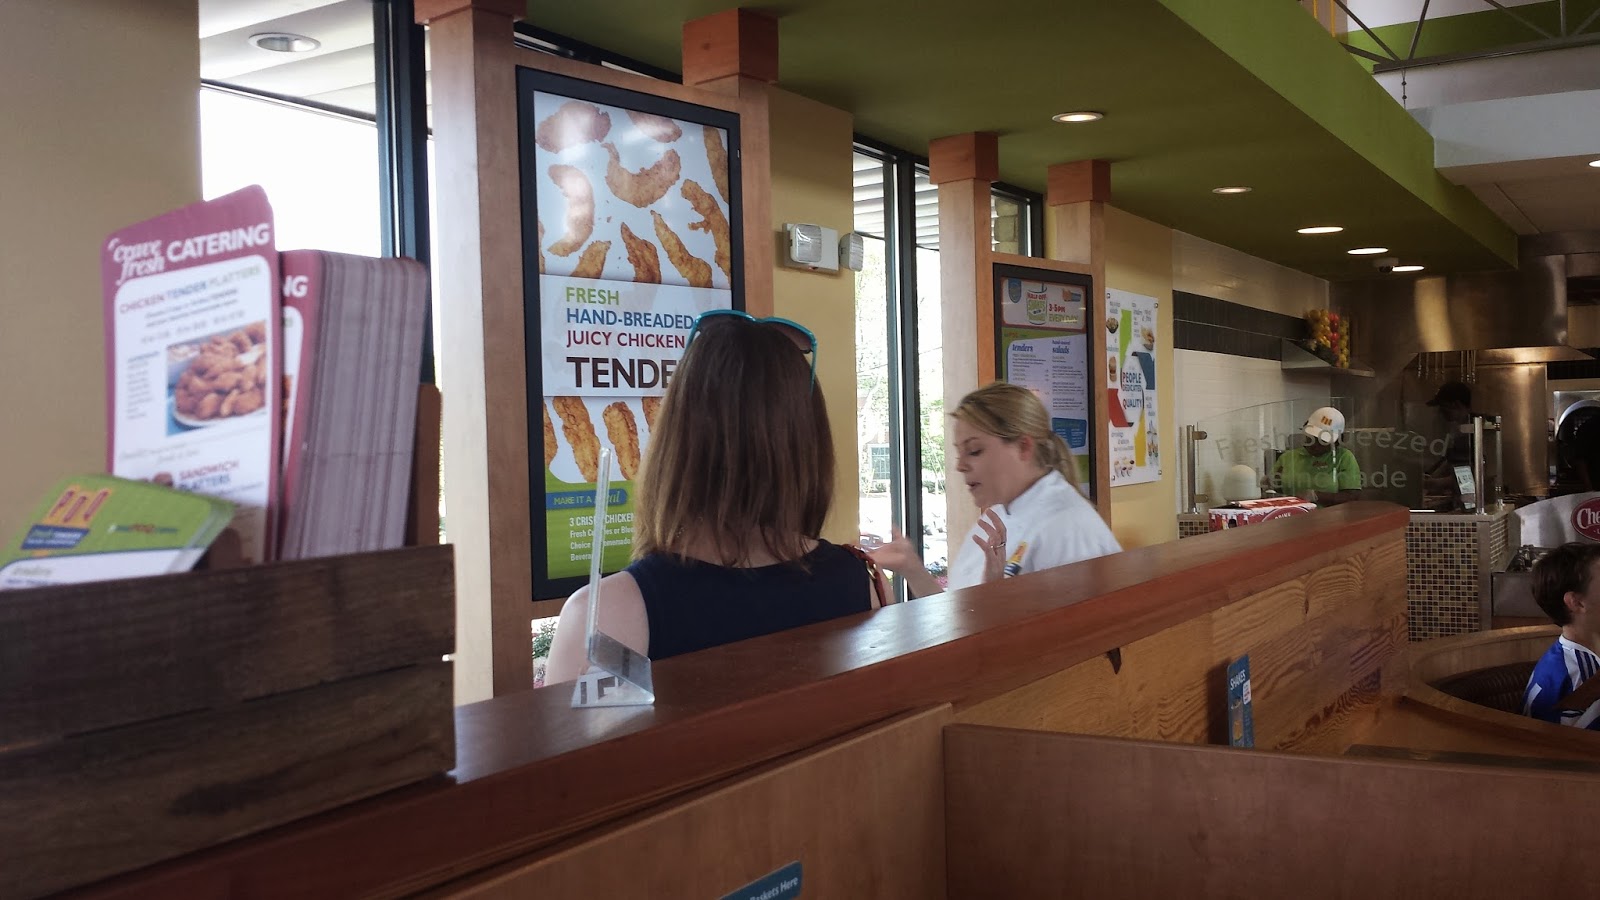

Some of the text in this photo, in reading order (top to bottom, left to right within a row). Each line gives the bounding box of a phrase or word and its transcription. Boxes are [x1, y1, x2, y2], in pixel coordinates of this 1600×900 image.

[167, 222, 271, 263] CATERING
[167, 280, 208, 299] TENDER
[566, 287, 620, 306] FRESH
[566, 308, 694, 330] HAND-BREADED
[566, 330, 685, 348] JUICY CHICKEN
[1012, 343, 1034, 352] tenders
[566, 357, 681, 388] TENDE
[1122, 372, 1142, 384] PEOPLE
[1122, 398, 1142, 409] QUALITY
[553, 496, 575, 505] MAKE
[586, 495, 593, 503] A
[569, 517, 575, 527] 3
[569, 529, 587, 538] Fresh
[570, 537, 631, 550] Choice omemade
[1230, 668, 1246, 690] SHAKES
[780, 877, 798, 892] Here
